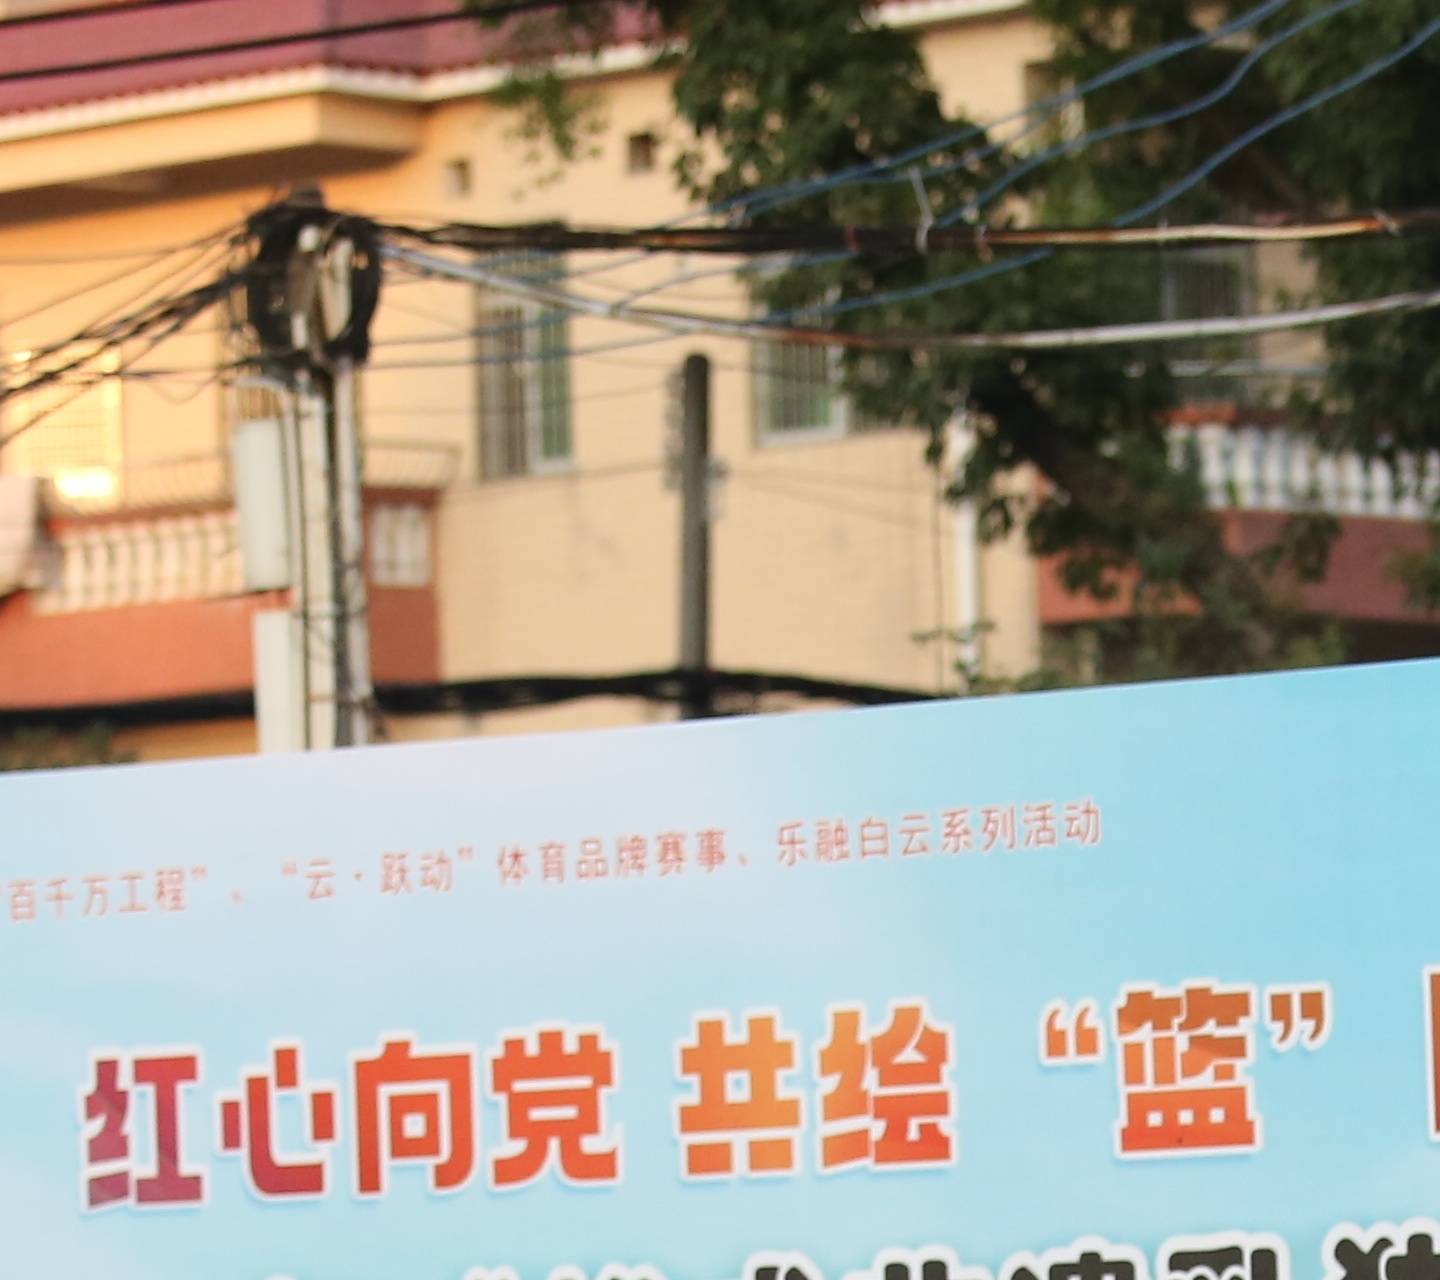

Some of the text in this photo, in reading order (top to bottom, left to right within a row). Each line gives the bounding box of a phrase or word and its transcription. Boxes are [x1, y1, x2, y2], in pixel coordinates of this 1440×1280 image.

[86, 1030, 618, 1208] 红心向党
[678, 1005, 954, 1176] 共绘
[1042, 985, 1333, 1155] “篮”
